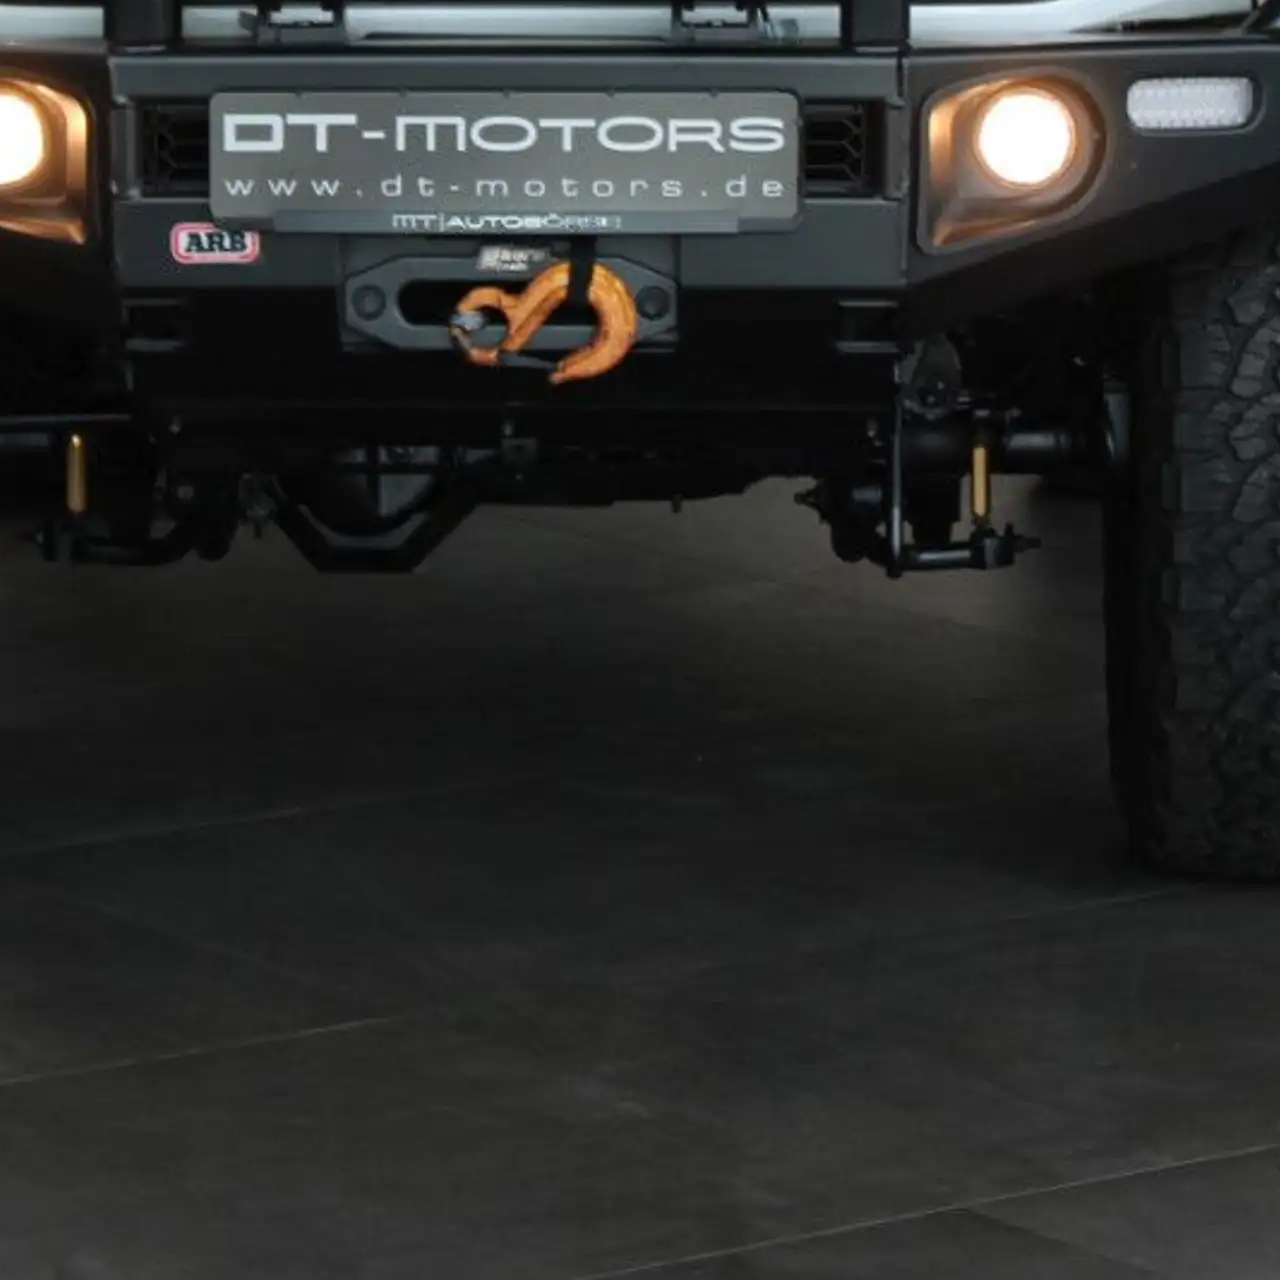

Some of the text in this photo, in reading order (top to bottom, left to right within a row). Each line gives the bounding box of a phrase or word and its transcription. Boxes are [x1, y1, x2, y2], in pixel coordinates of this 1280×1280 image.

[223, 113, 786, 152] DT-MOTORS
[224, 173, 785, 197] www.dt-motors.de
[184, 231, 247, 253] ARB
